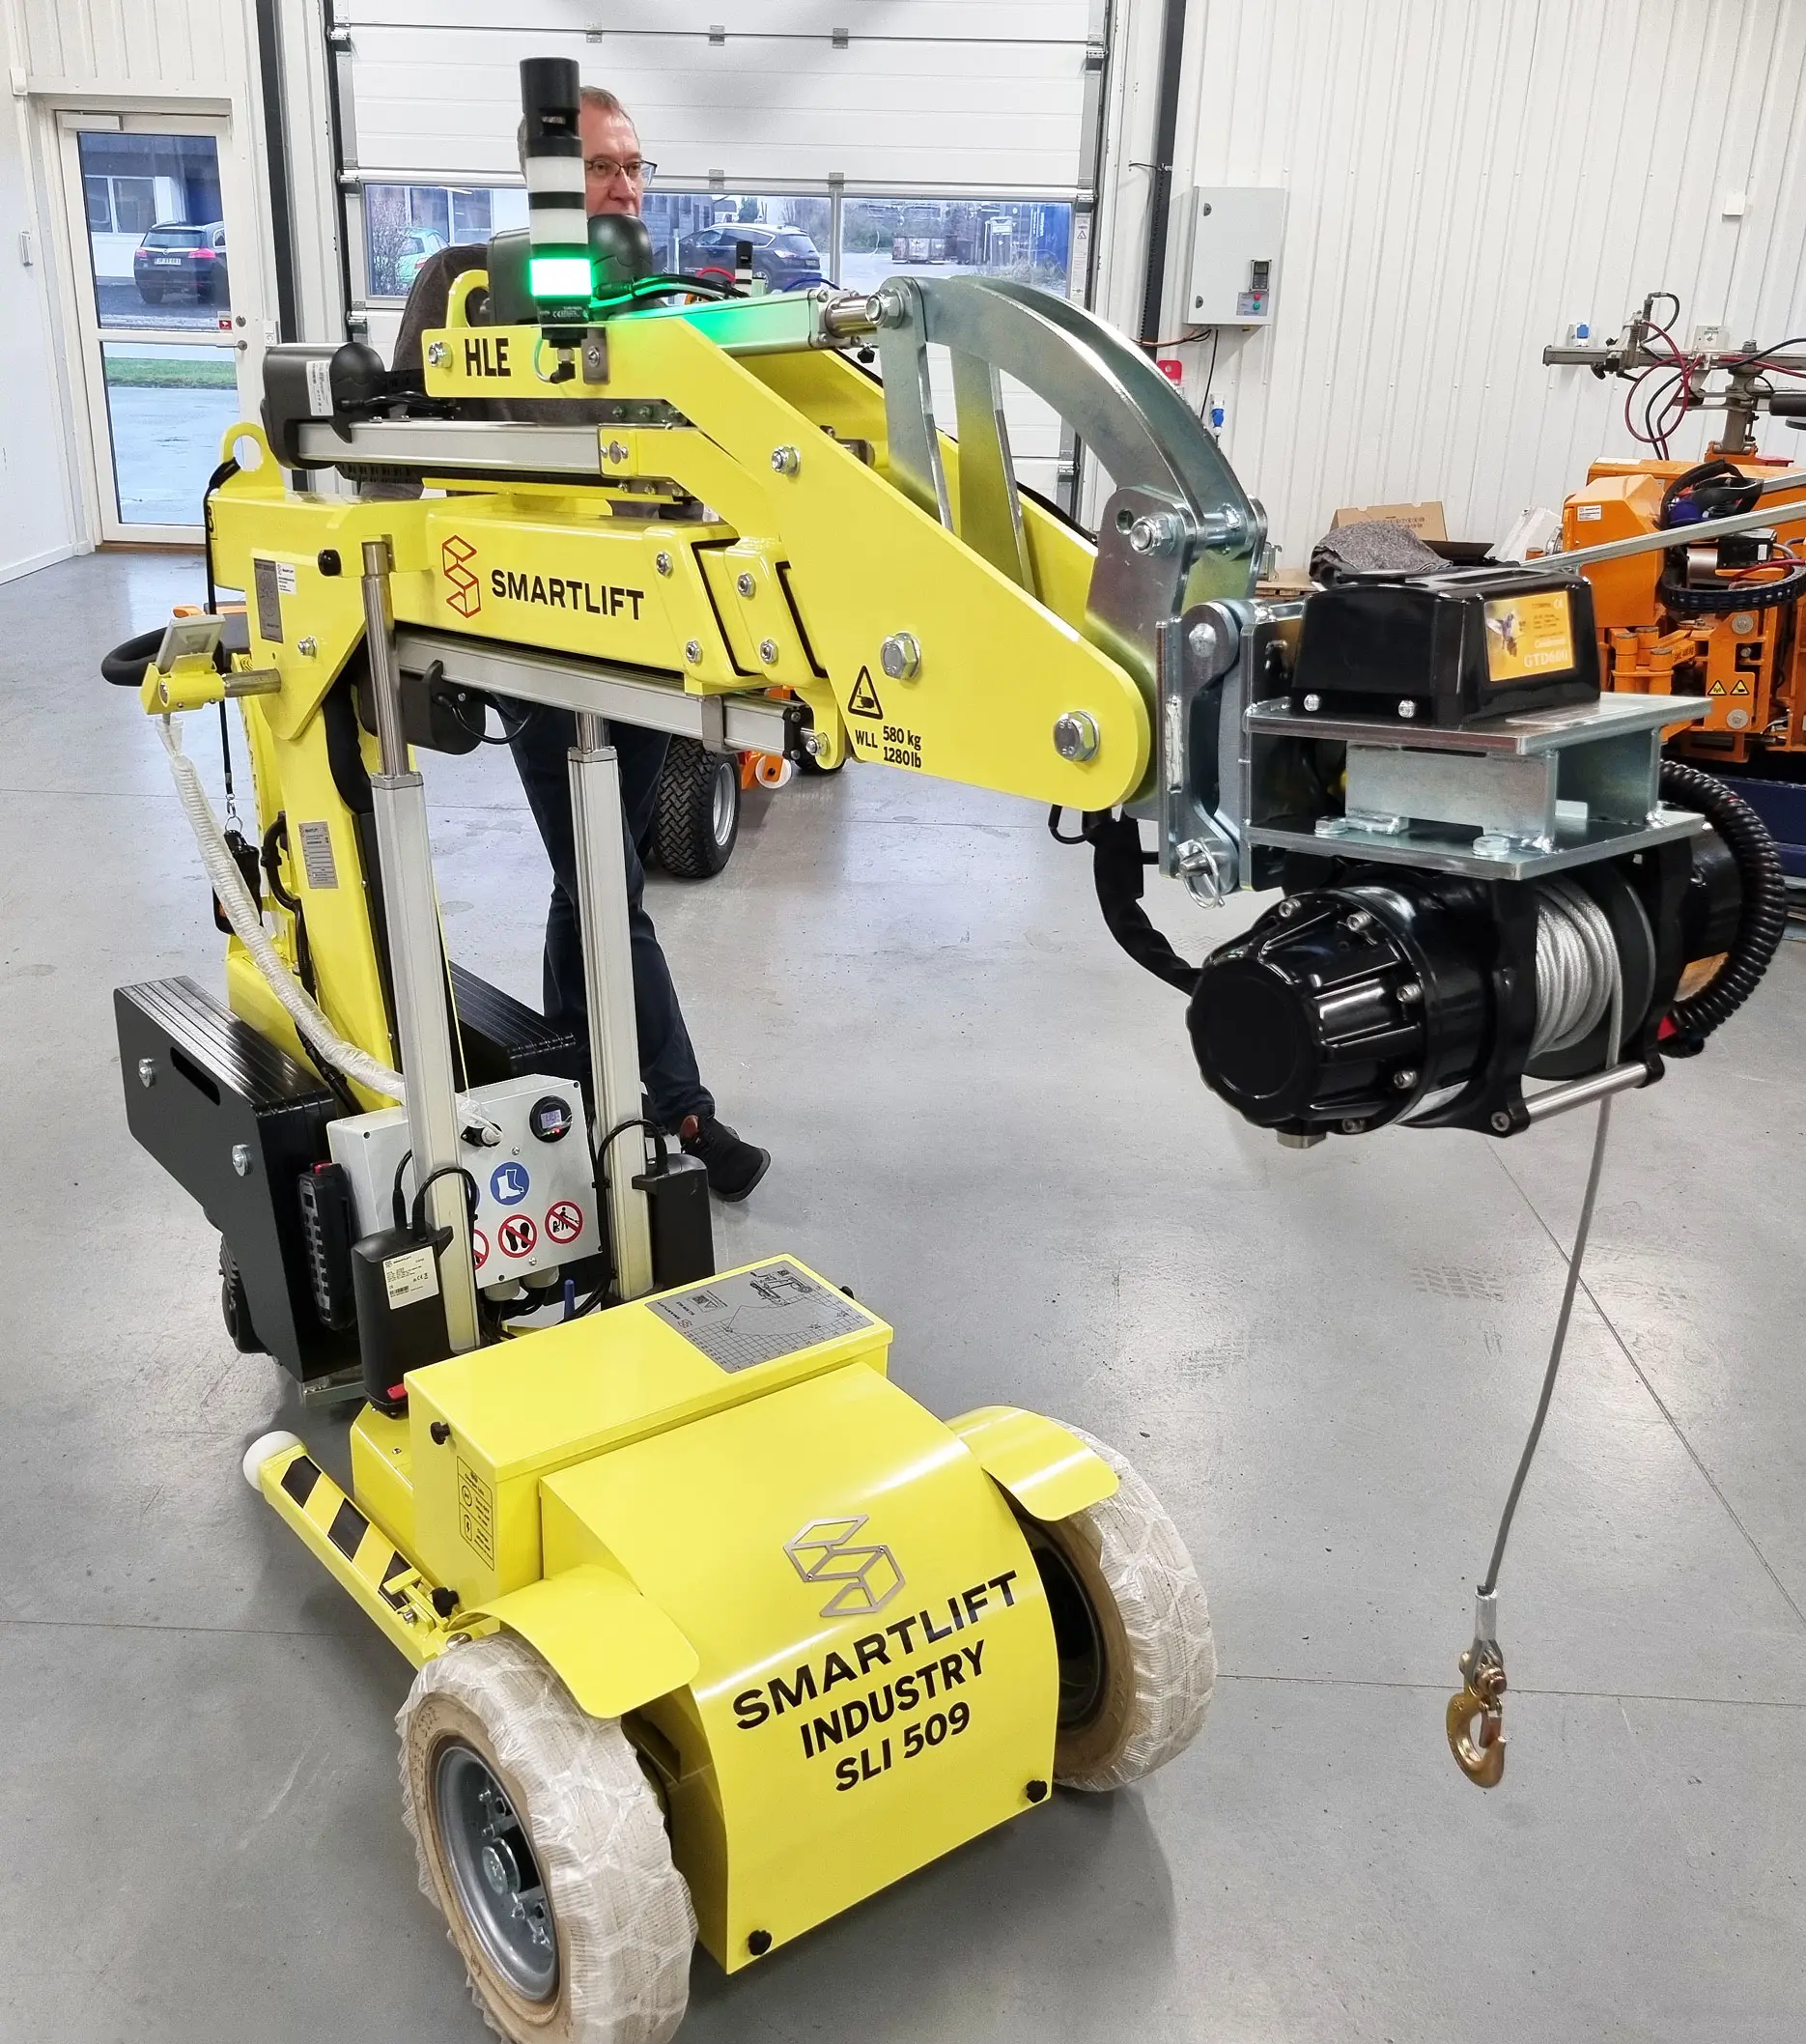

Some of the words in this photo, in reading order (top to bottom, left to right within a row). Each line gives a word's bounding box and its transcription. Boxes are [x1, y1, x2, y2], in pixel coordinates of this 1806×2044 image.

[465, 338, 511, 377] HLE
[492, 569, 645, 620] SMARTLIFT
[855, 729, 878, 749] WLL
[883, 725, 904, 744] 580
[907, 729, 921, 751] kg
[732, 1570, 1017, 1729] SMARTLIFT
[800, 1639, 985, 1759] INDUSTRY
[835, 1738, 892, 1792] SLI
[903, 1702, 970, 1758] 509
